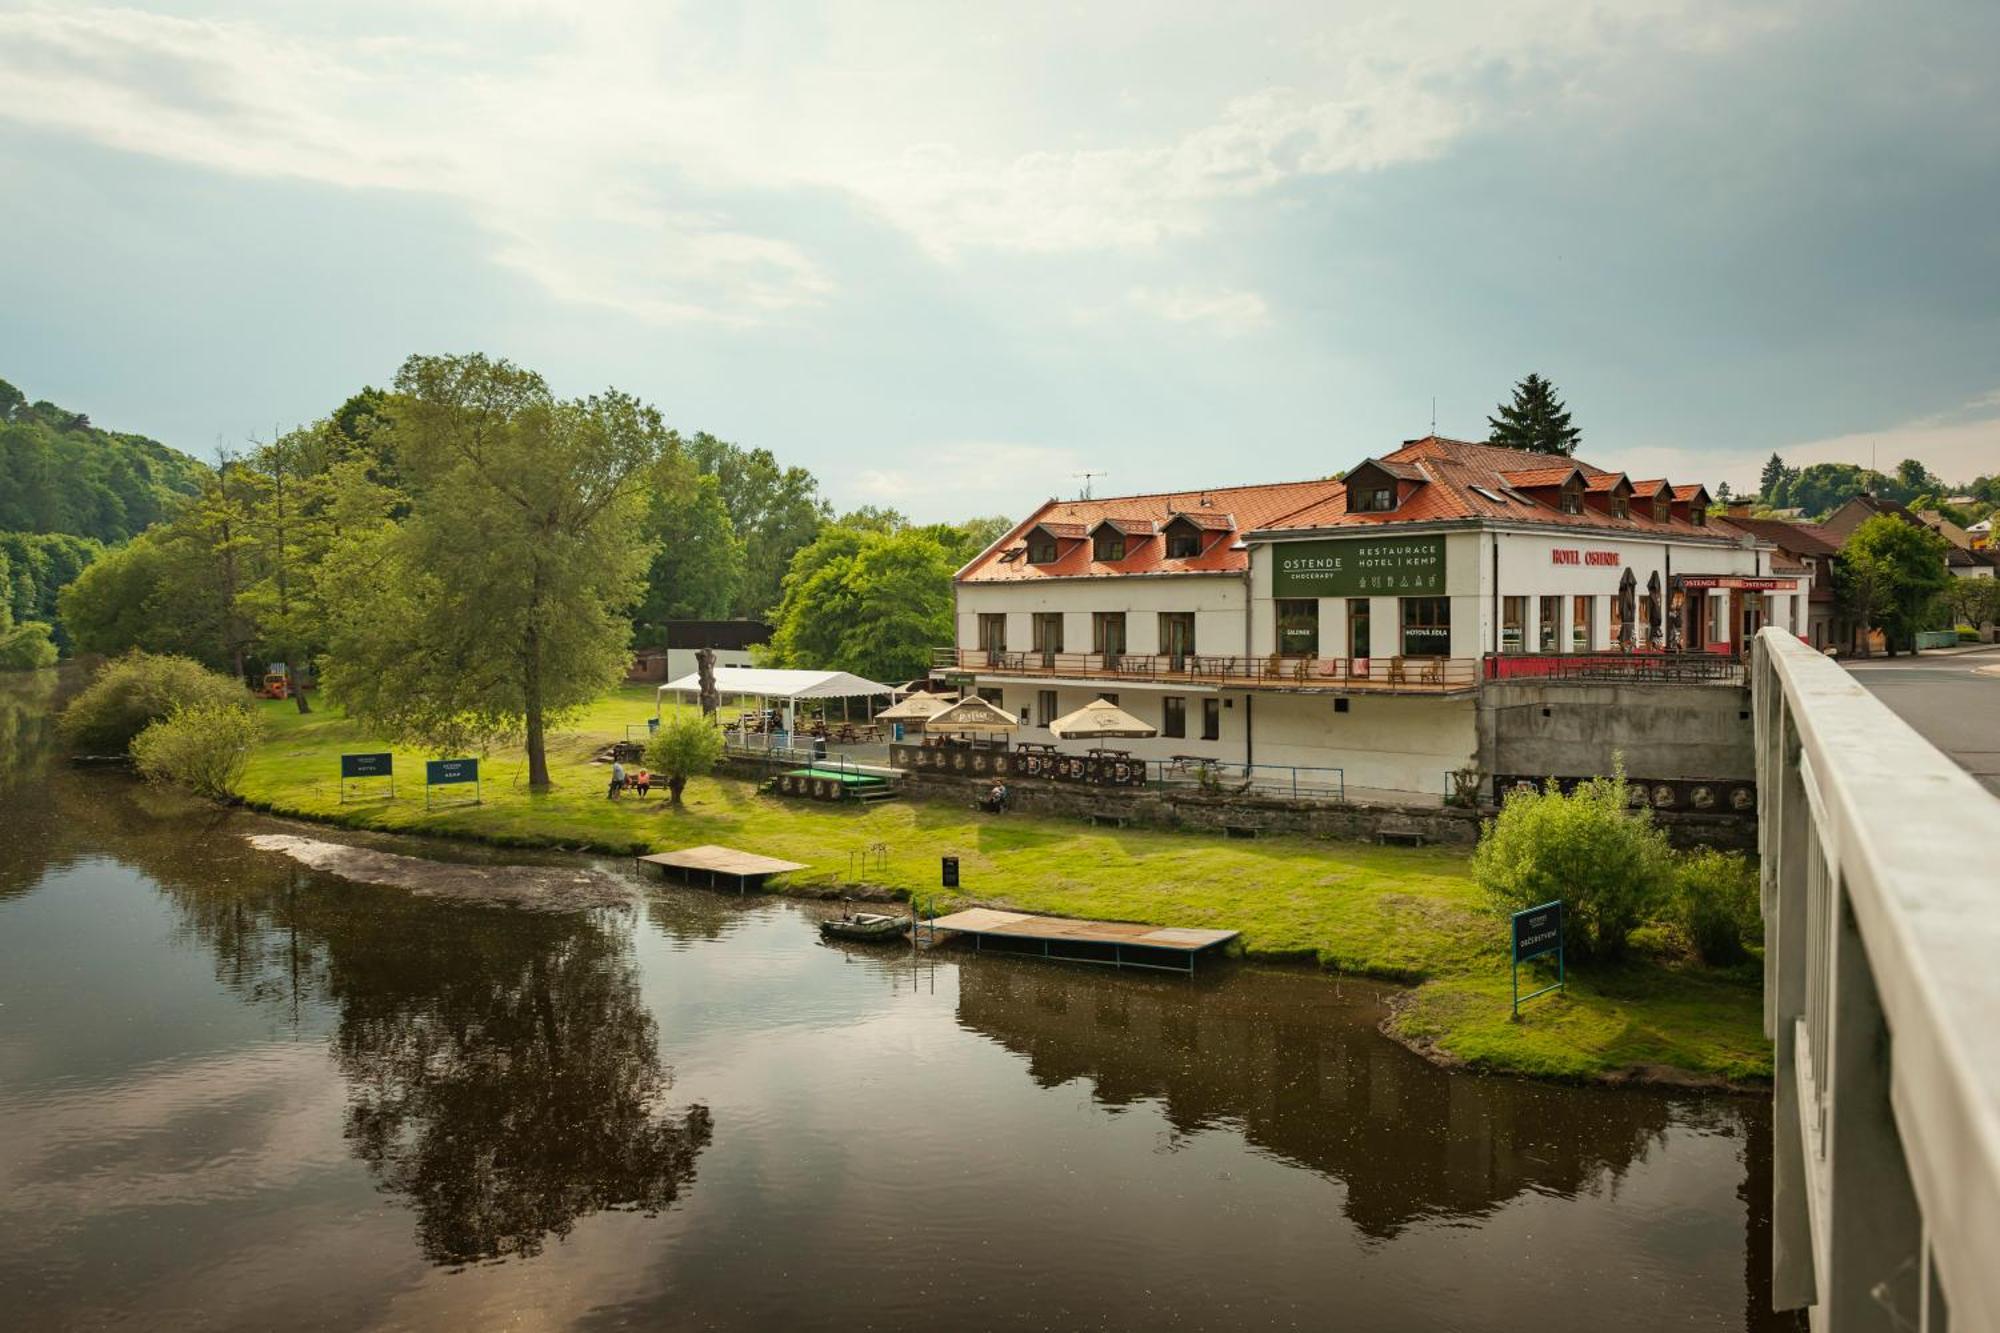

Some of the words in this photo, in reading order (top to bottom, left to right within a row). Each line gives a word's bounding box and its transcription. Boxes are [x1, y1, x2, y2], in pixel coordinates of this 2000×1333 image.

[1359, 545, 1436, 556] RESTAURACE
[1283, 557, 1342, 569] OSTENDE
[1359, 559, 1393, 567] HOTEL
[1406, 557, 1436, 566] KEMP
[1552, 549, 1580, 565] HOTEL
[1584, 550, 1620, 566] OSTENDE
